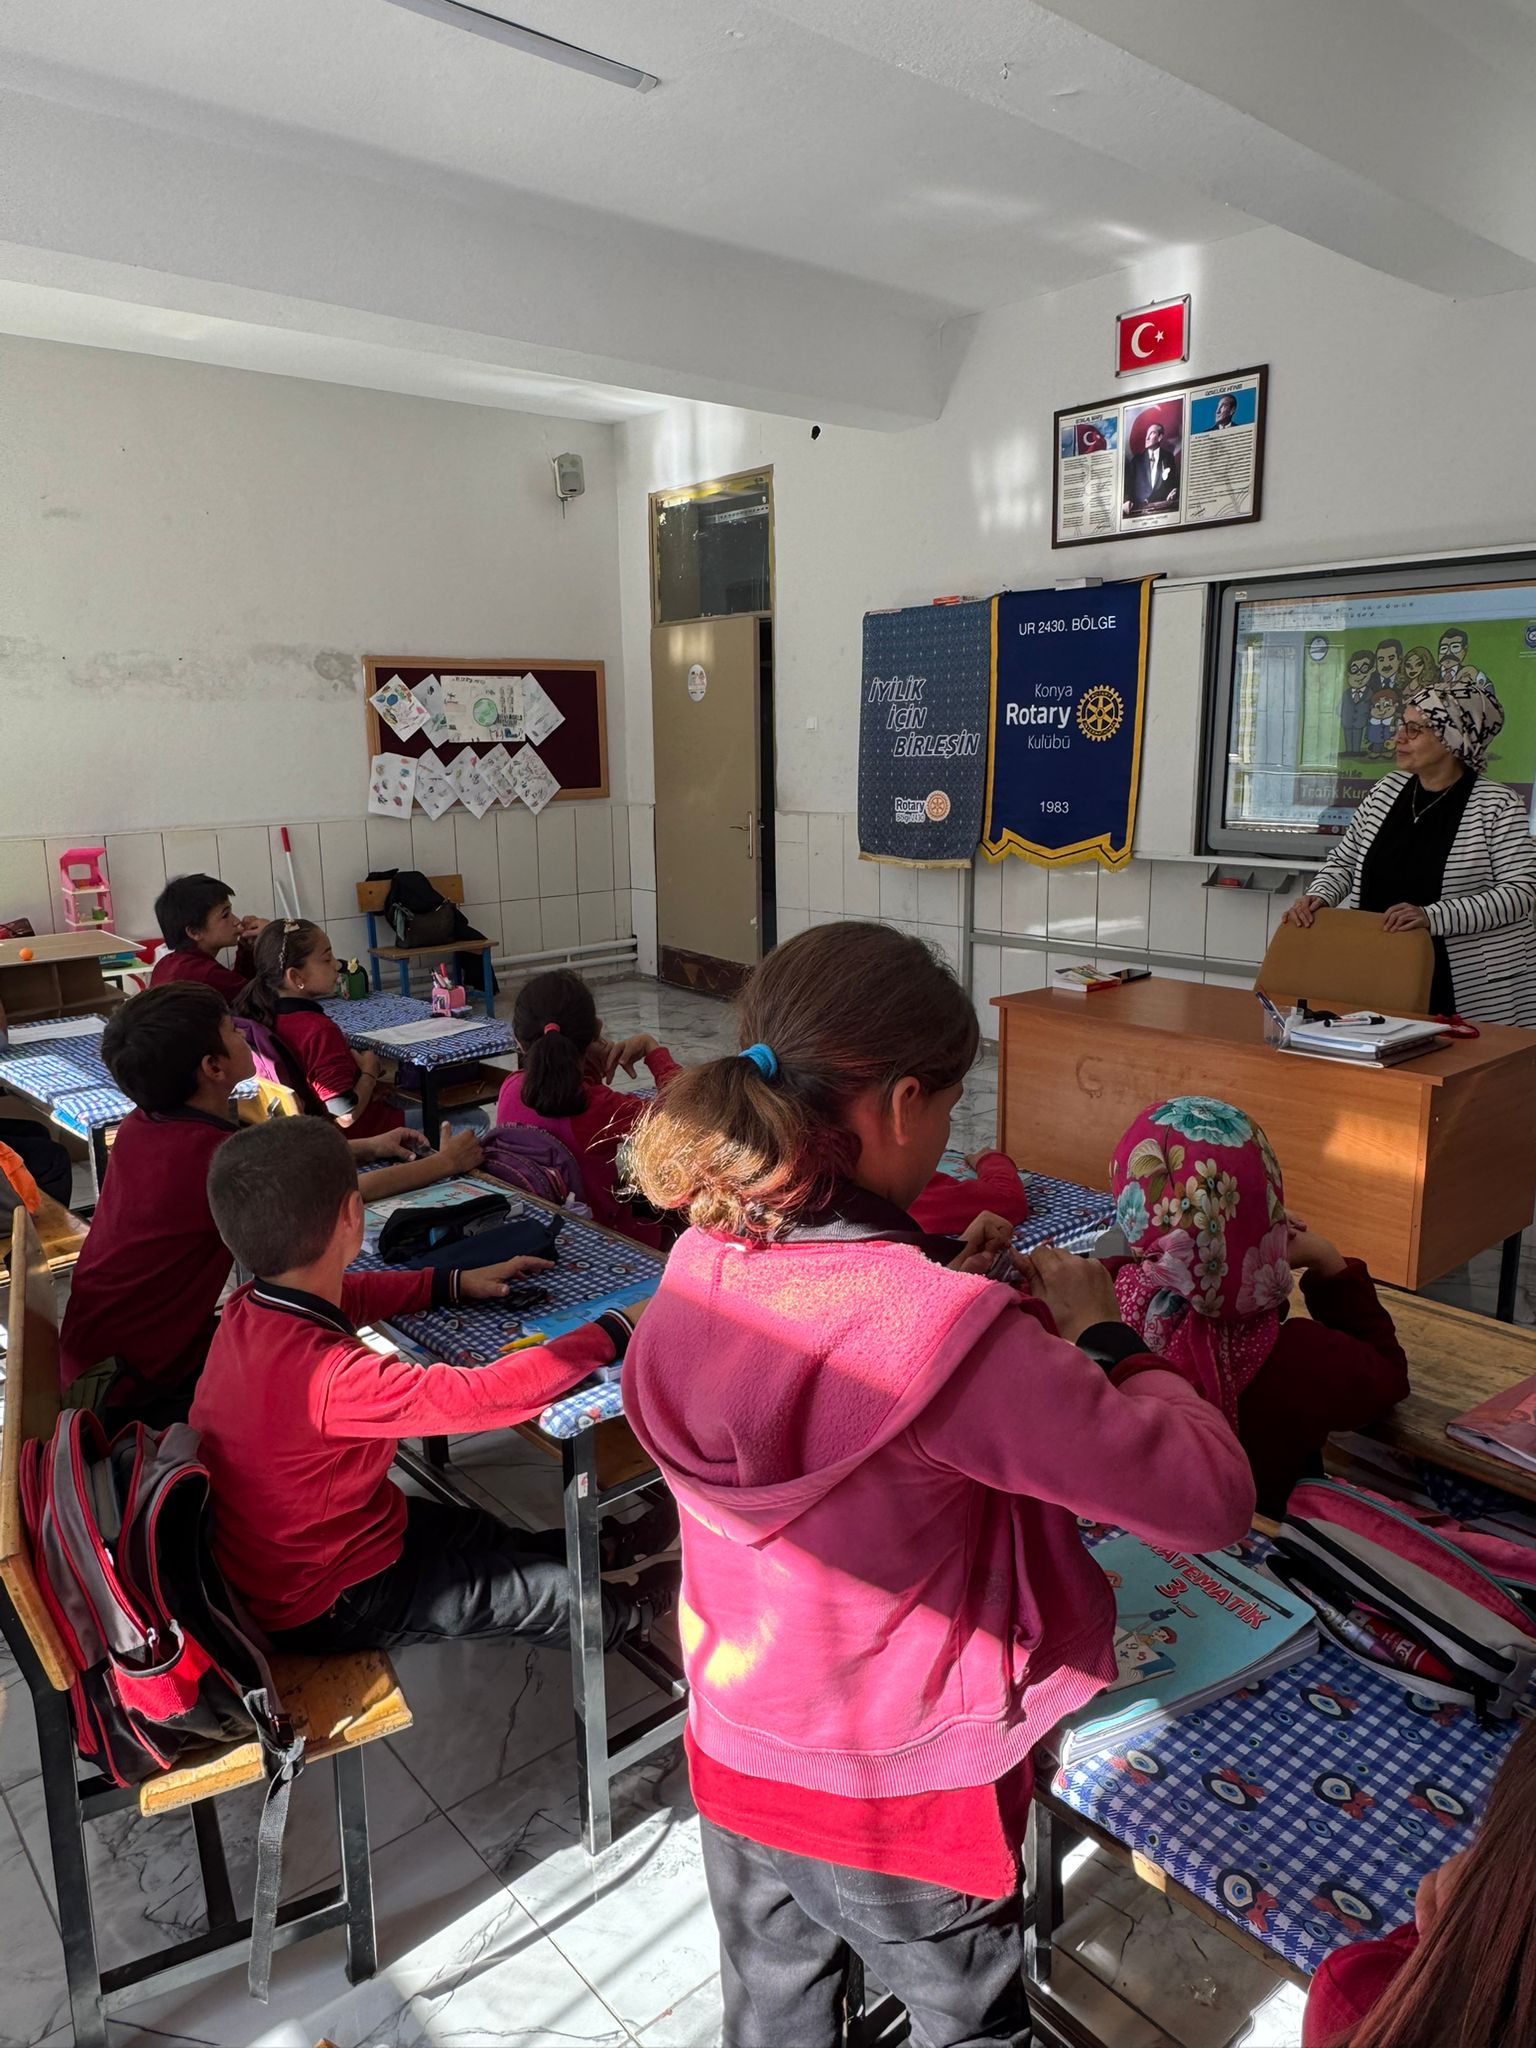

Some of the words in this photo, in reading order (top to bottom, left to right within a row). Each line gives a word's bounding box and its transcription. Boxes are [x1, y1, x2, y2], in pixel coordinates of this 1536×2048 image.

[1018, 622, 1036, 636] UR
[1038, 619, 1069, 634] 2430.
[1071, 614, 1117, 631] BÖLGE
[867, 674, 927, 703] İYİLİK
[1034, 682, 1073, 702] Konya
[886, 702, 928, 733] İÇİN
[1005, 702, 1072, 729] Rotary
[893, 728, 981, 759] BİRLEŞİN
[1027, 732, 1071, 750] Kulübü
[1300, 783, 1340, 799] Trafik
[1342, 785, 1369, 799] Kur
[895, 797, 925, 814] Rotary
[1039, 800, 1070, 814] 1983
